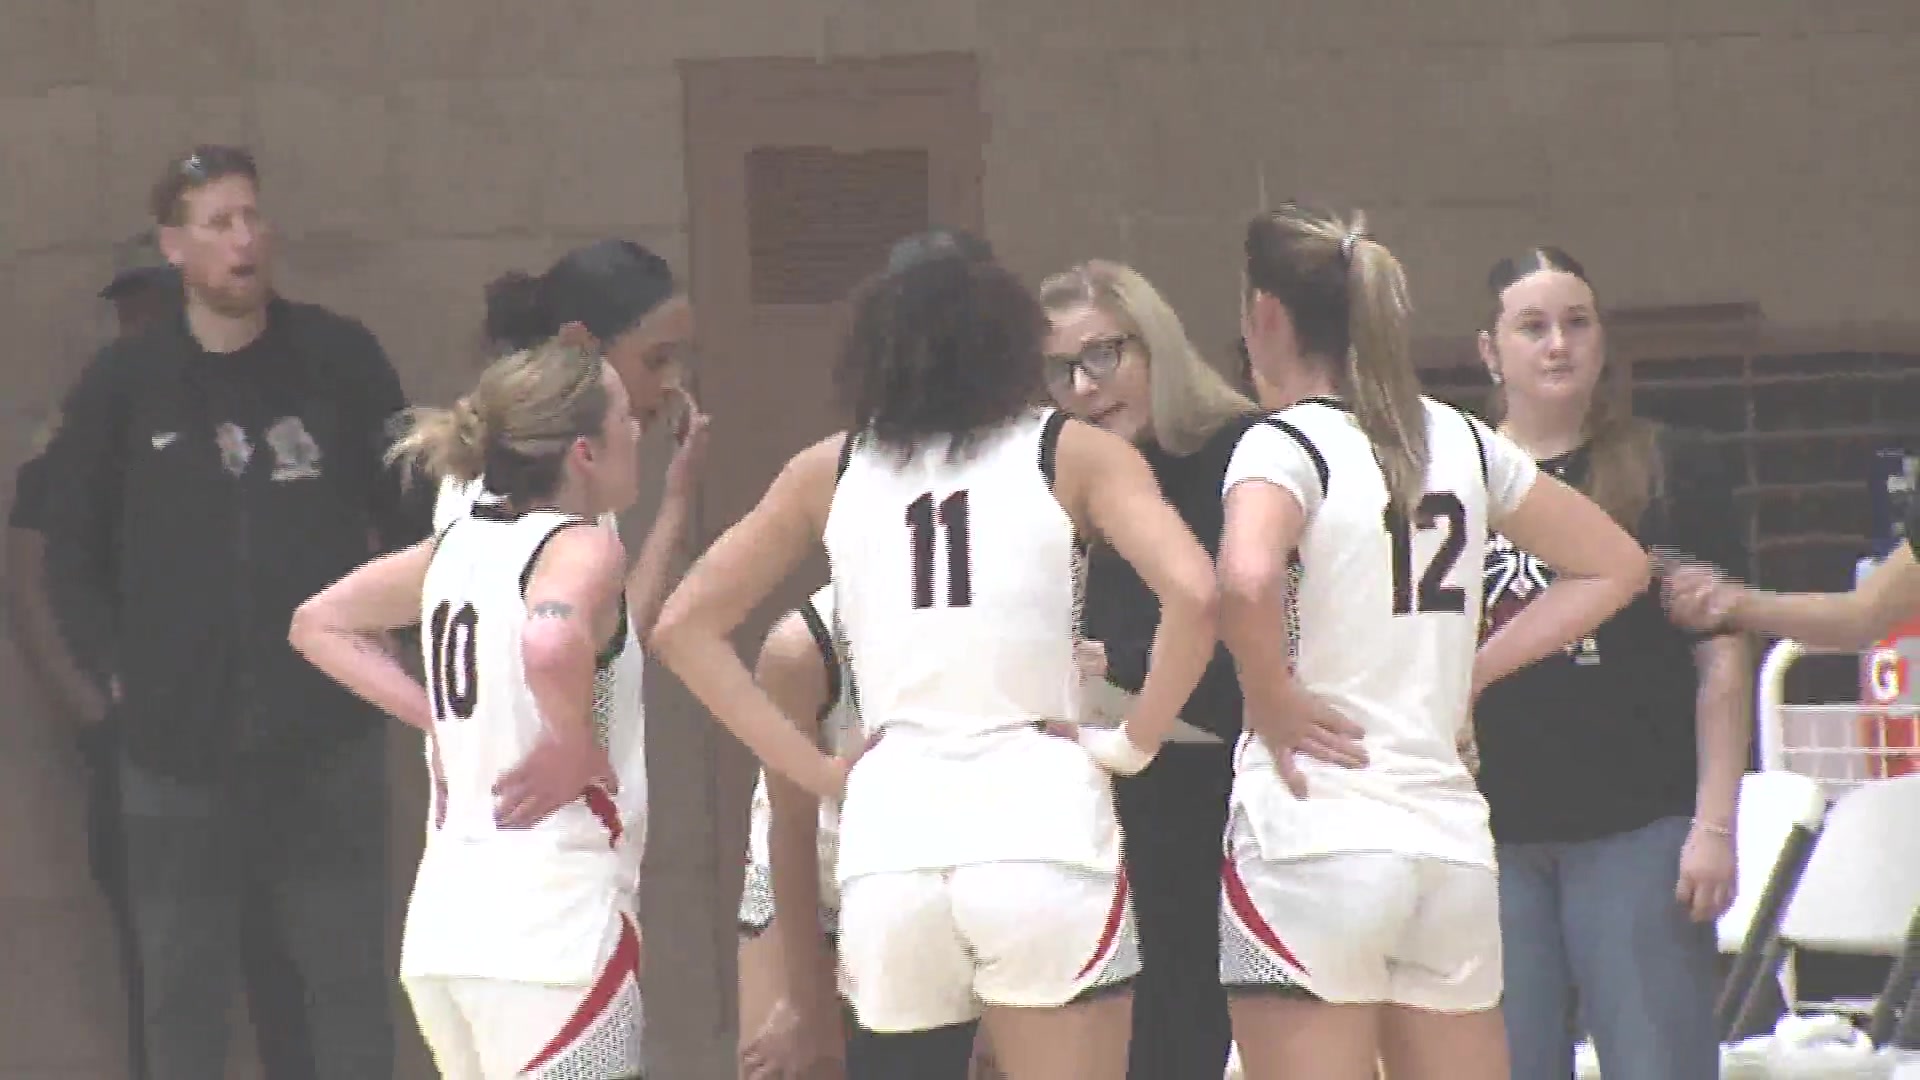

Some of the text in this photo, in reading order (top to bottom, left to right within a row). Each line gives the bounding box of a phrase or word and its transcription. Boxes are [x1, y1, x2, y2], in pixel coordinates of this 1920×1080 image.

[905, 489, 971, 608] 11
[1383, 492, 1466, 613] 12
[431, 600, 478, 720] 10
[1871, 649, 1899, 700] G
